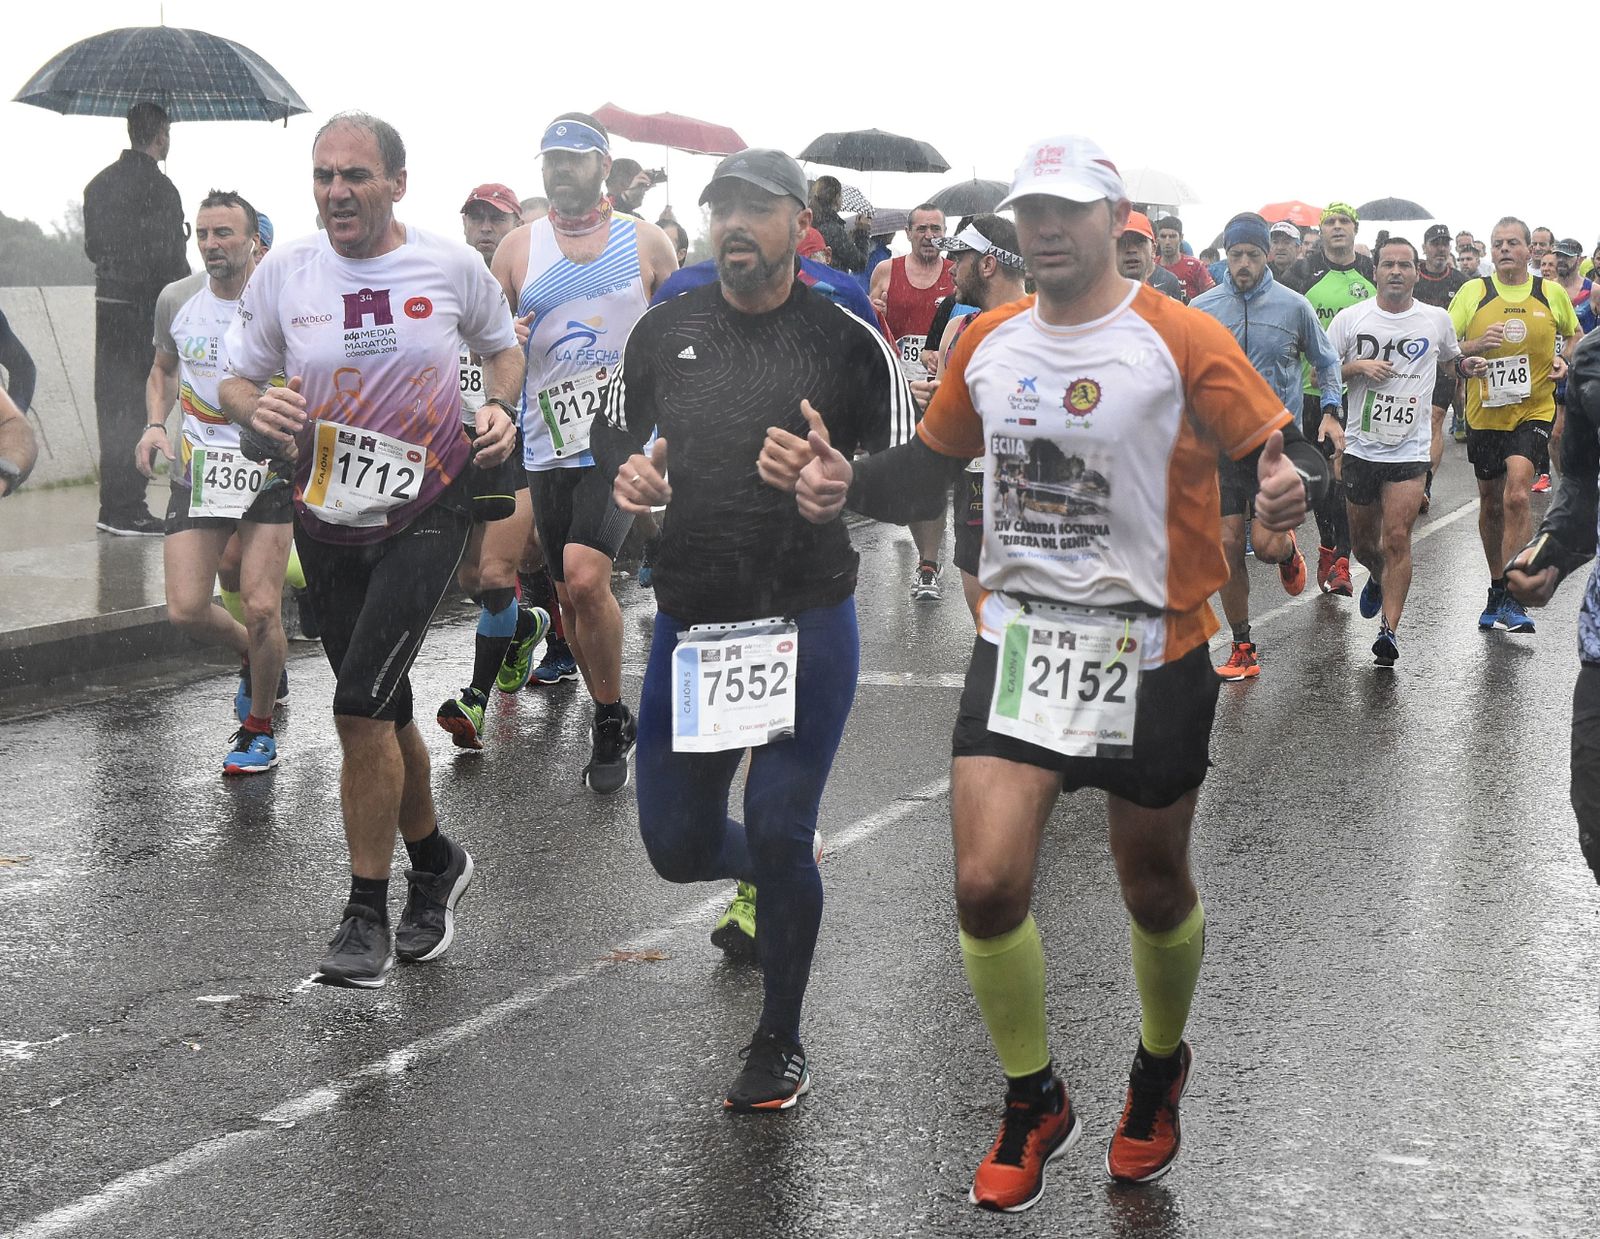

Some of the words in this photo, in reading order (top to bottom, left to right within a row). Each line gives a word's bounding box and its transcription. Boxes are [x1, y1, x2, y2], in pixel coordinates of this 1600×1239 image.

[585, 287, 614, 300] DESDE
[614, 280, 632, 292] 1996
[360, 294, 373, 302] 34
[411, 303, 426, 312] edp
[344, 331, 360, 341] edp
[361, 327, 396, 338] MEDIA
[345, 338, 397, 350] MARATÓN
[345, 349, 380, 358] CÓRDOBA
[381, 346, 398, 354] 2018
[556, 350, 572, 361] LA
[576, 349, 619, 361] PECHA
[903, 346, 923, 361] 59
[1489, 367, 1528, 388] 1748
[1372, 404, 1414, 424] 2145
[317, 453, 329, 485] CAJÓN
[338, 452, 415, 500] 1712
[205, 466, 262, 492] 4360
[994, 521, 1012, 532] XIV
[1014, 522, 1056, 535] CARRERA
[1059, 523, 1110, 536] NOCTURNA
[1041, 537, 1058, 550] DEL
[703, 661, 789, 706] 7552
[1028, 655, 1128, 704] 2152
